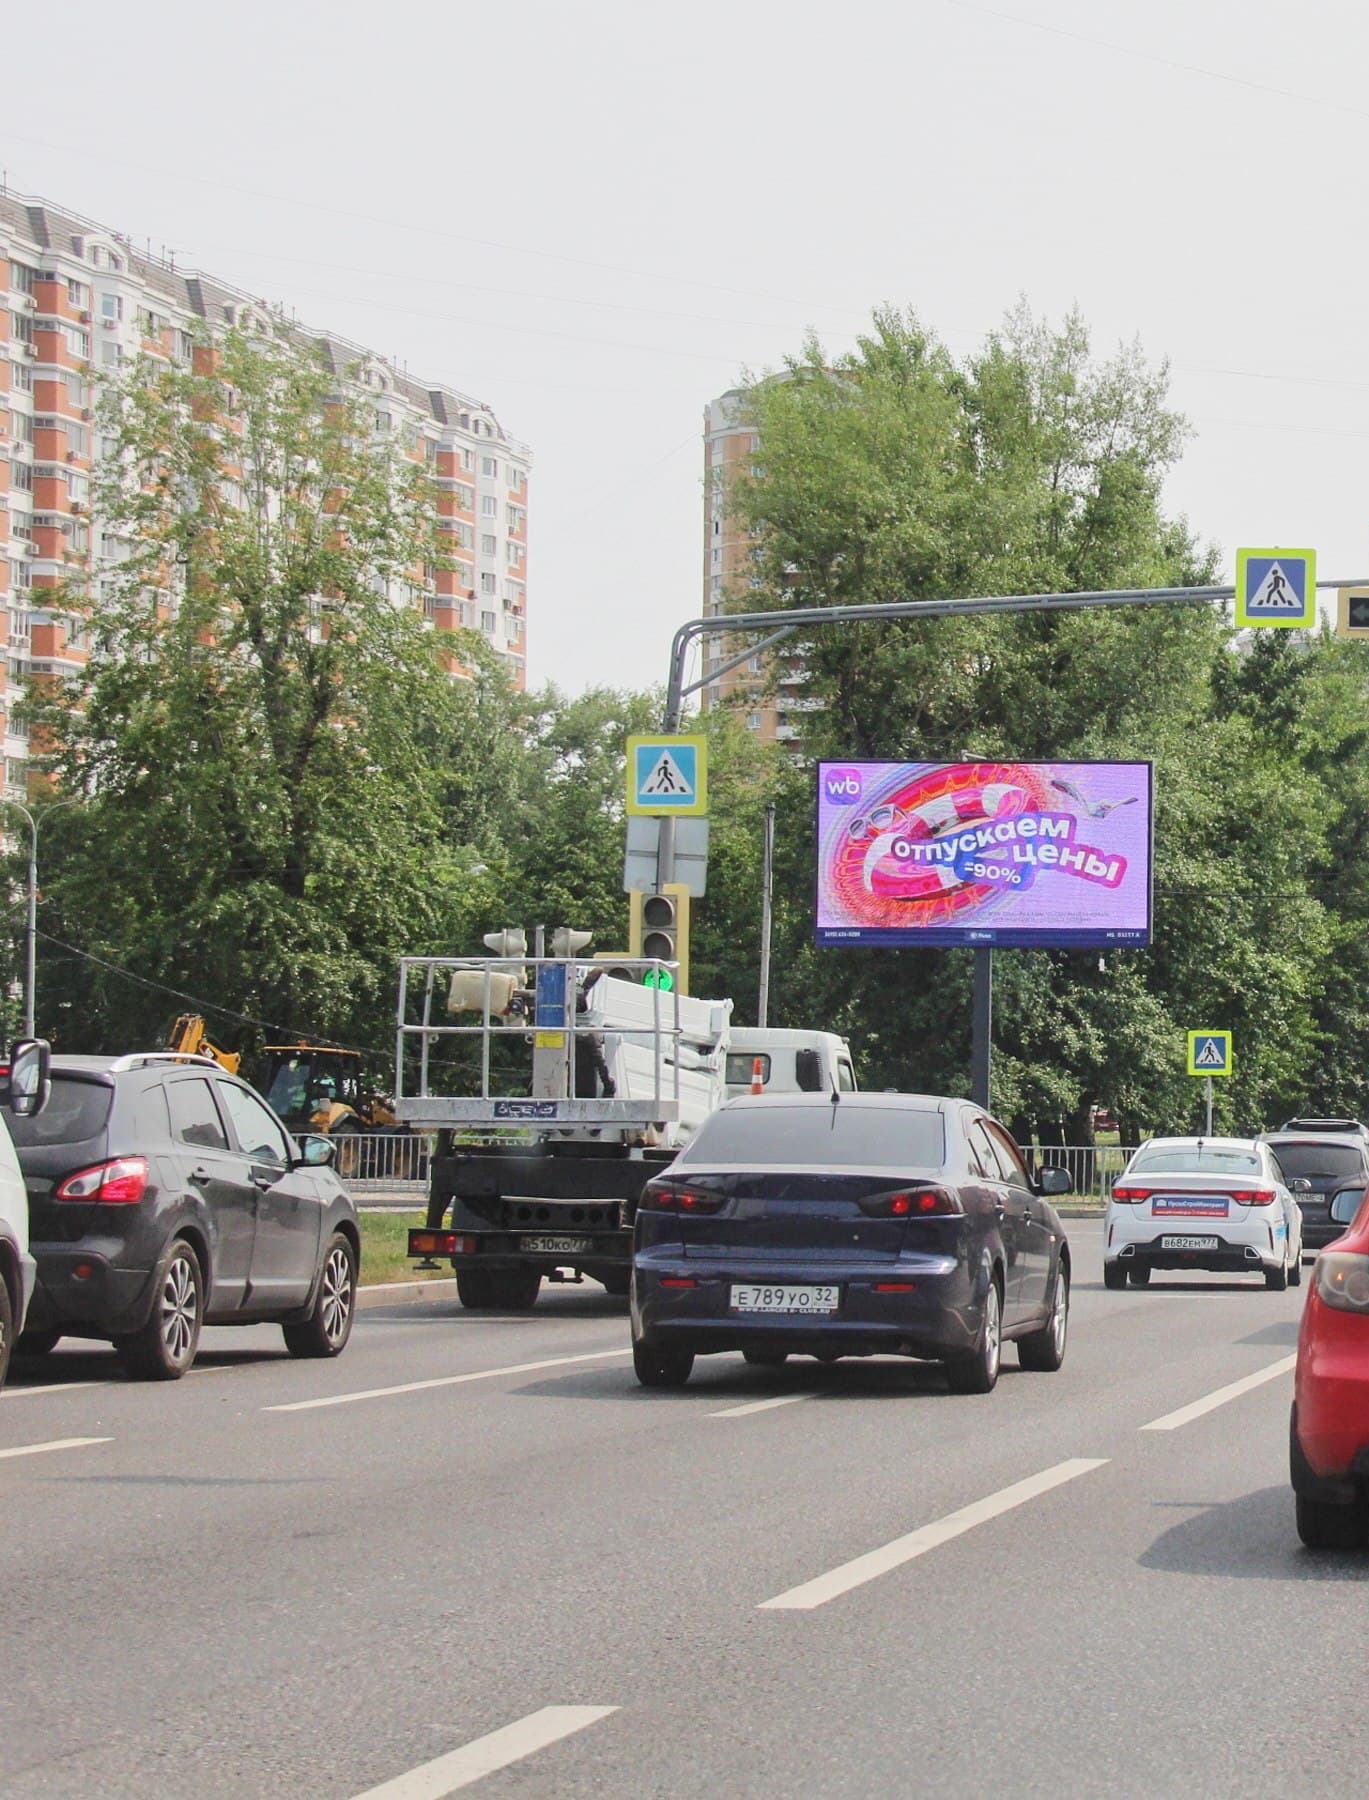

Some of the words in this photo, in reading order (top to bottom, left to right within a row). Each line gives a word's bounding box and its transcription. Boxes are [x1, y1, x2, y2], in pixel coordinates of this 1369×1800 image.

[828, 775, 860, 795] wb
[895, 817, 1070, 862] отпускаем
[1012, 844, 1120, 881] цены
[738, 1287, 810, 1306] Е789УО
[815, 1287, 832, 1302] 32
